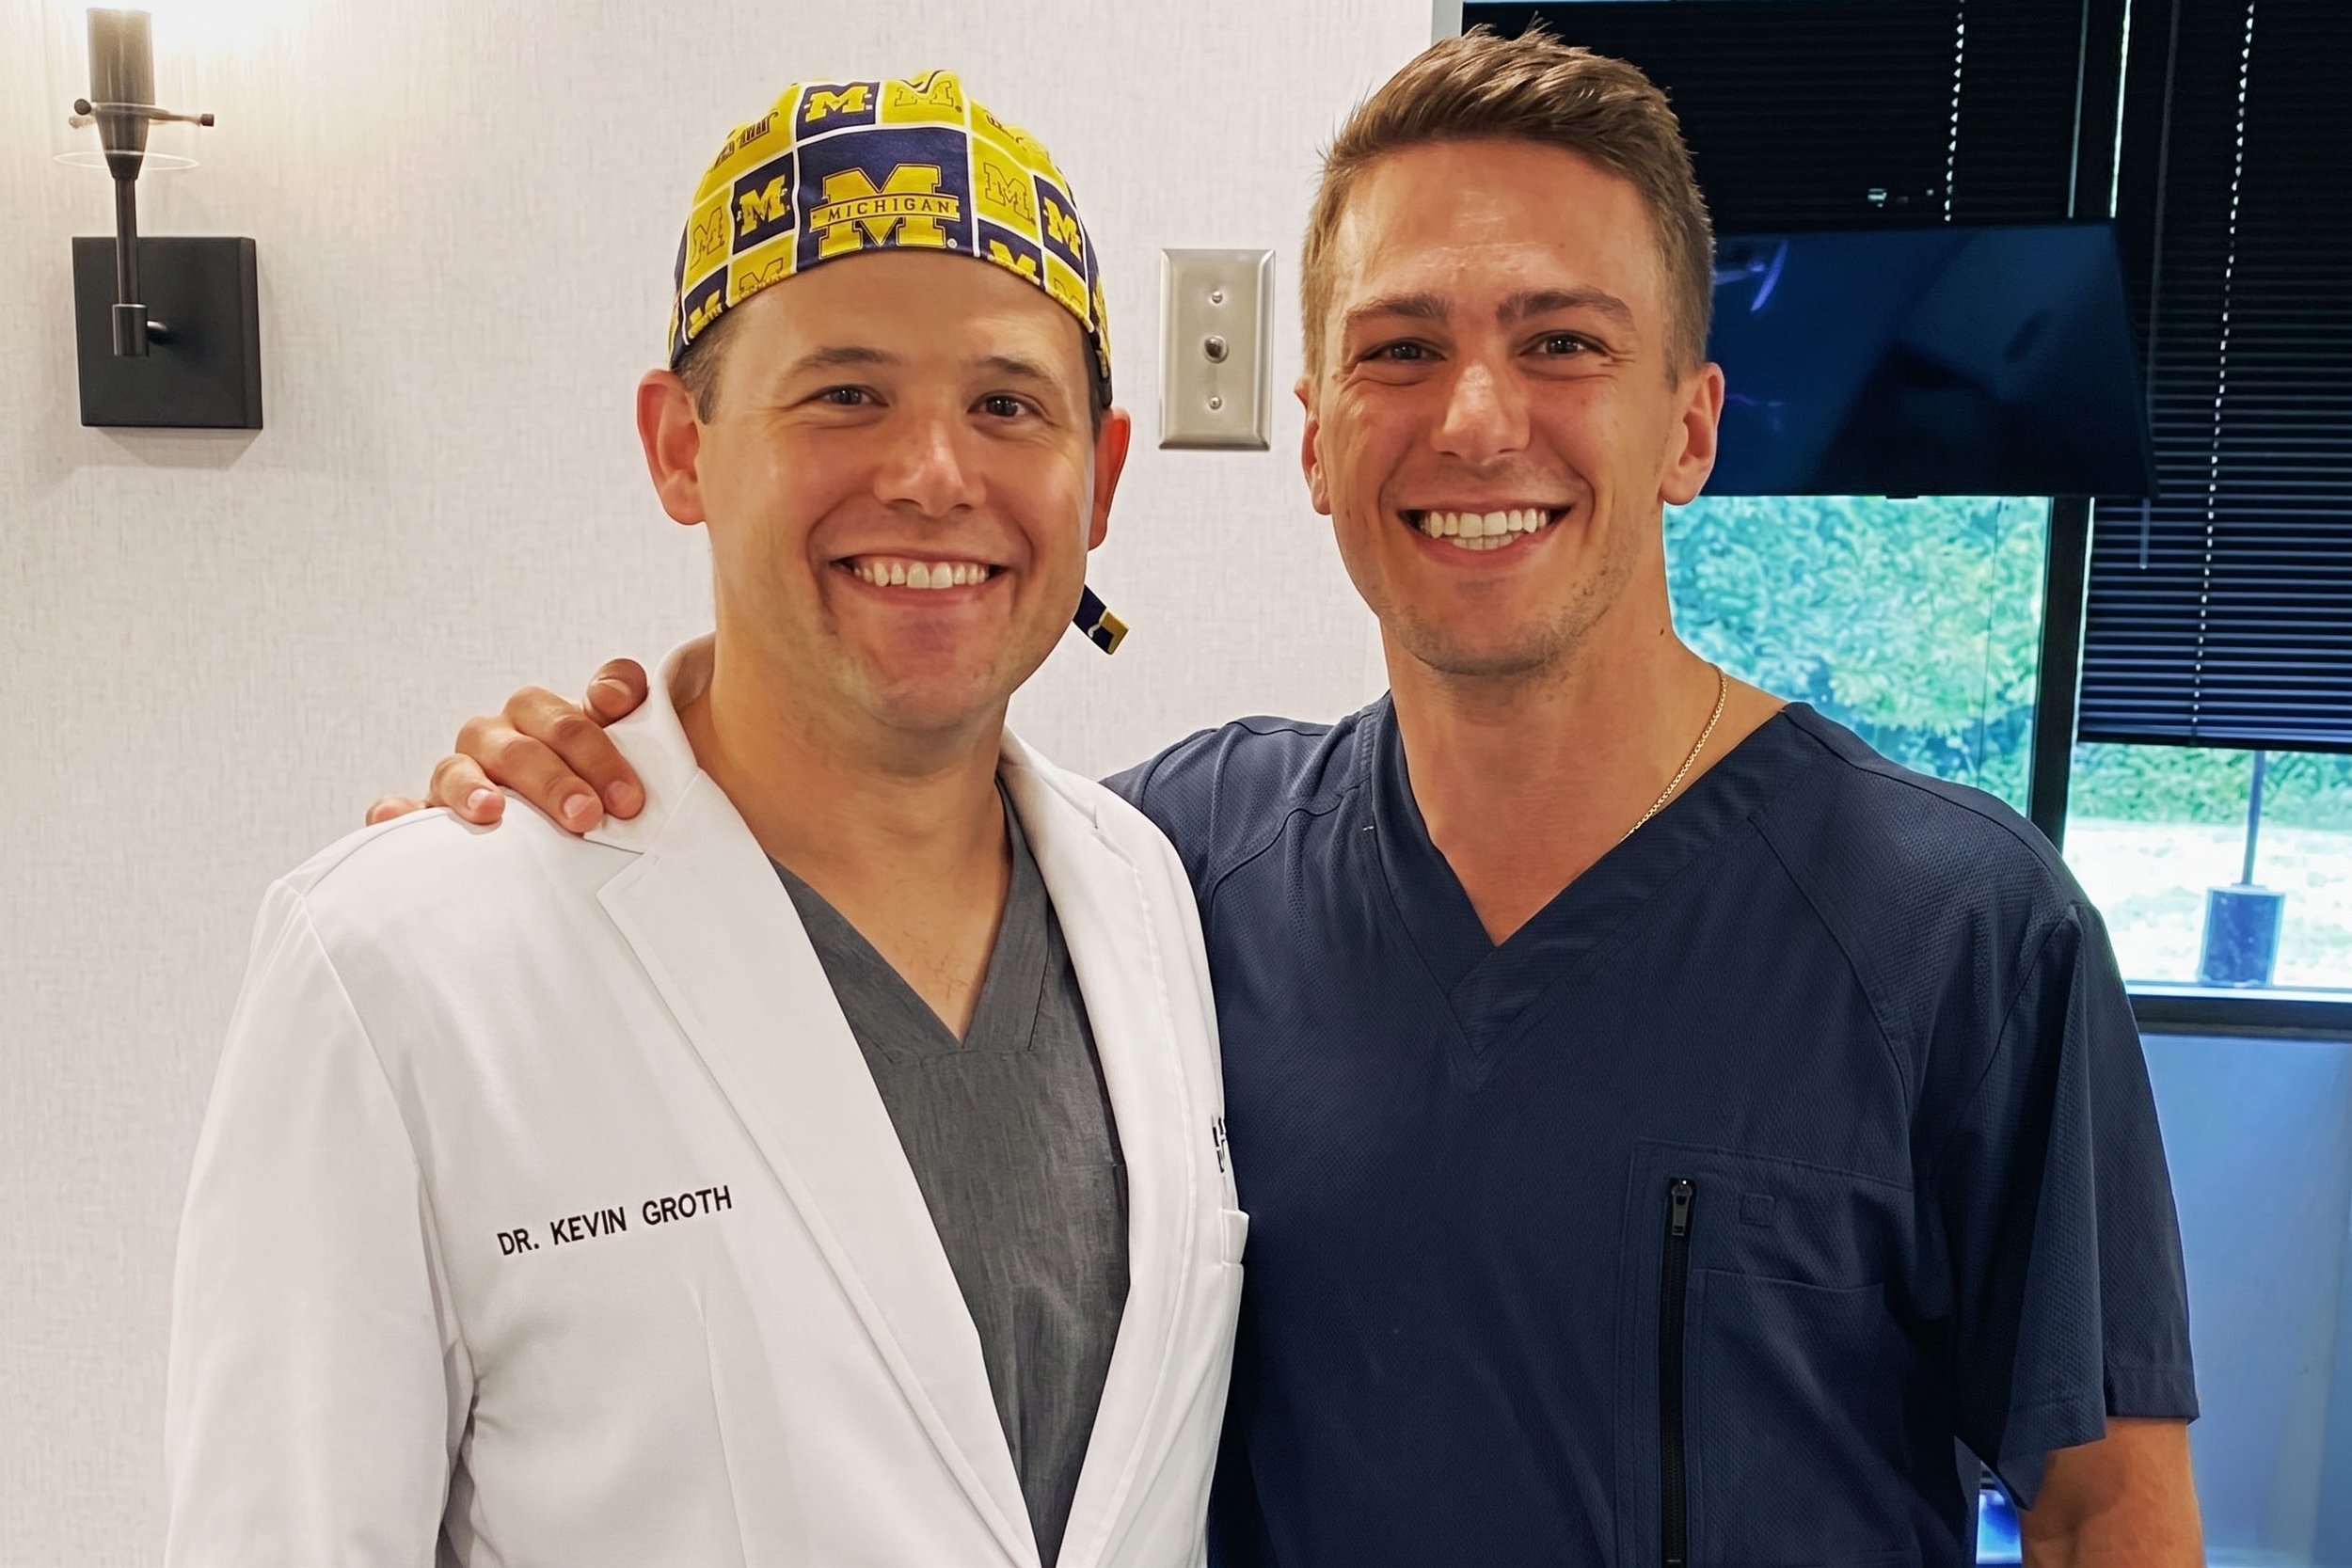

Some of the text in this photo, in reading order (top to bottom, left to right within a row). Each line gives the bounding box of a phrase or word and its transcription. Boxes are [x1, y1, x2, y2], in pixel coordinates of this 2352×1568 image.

[805, 86, 869, 123] M
[740, 175, 787, 236] M
[827, 198, 950, 223] MICHIGAN
[984, 162, 1030, 220] M
[1043, 197, 1082, 263] M
[497, 1185, 732, 1256] DR. KEVIN GROTH
